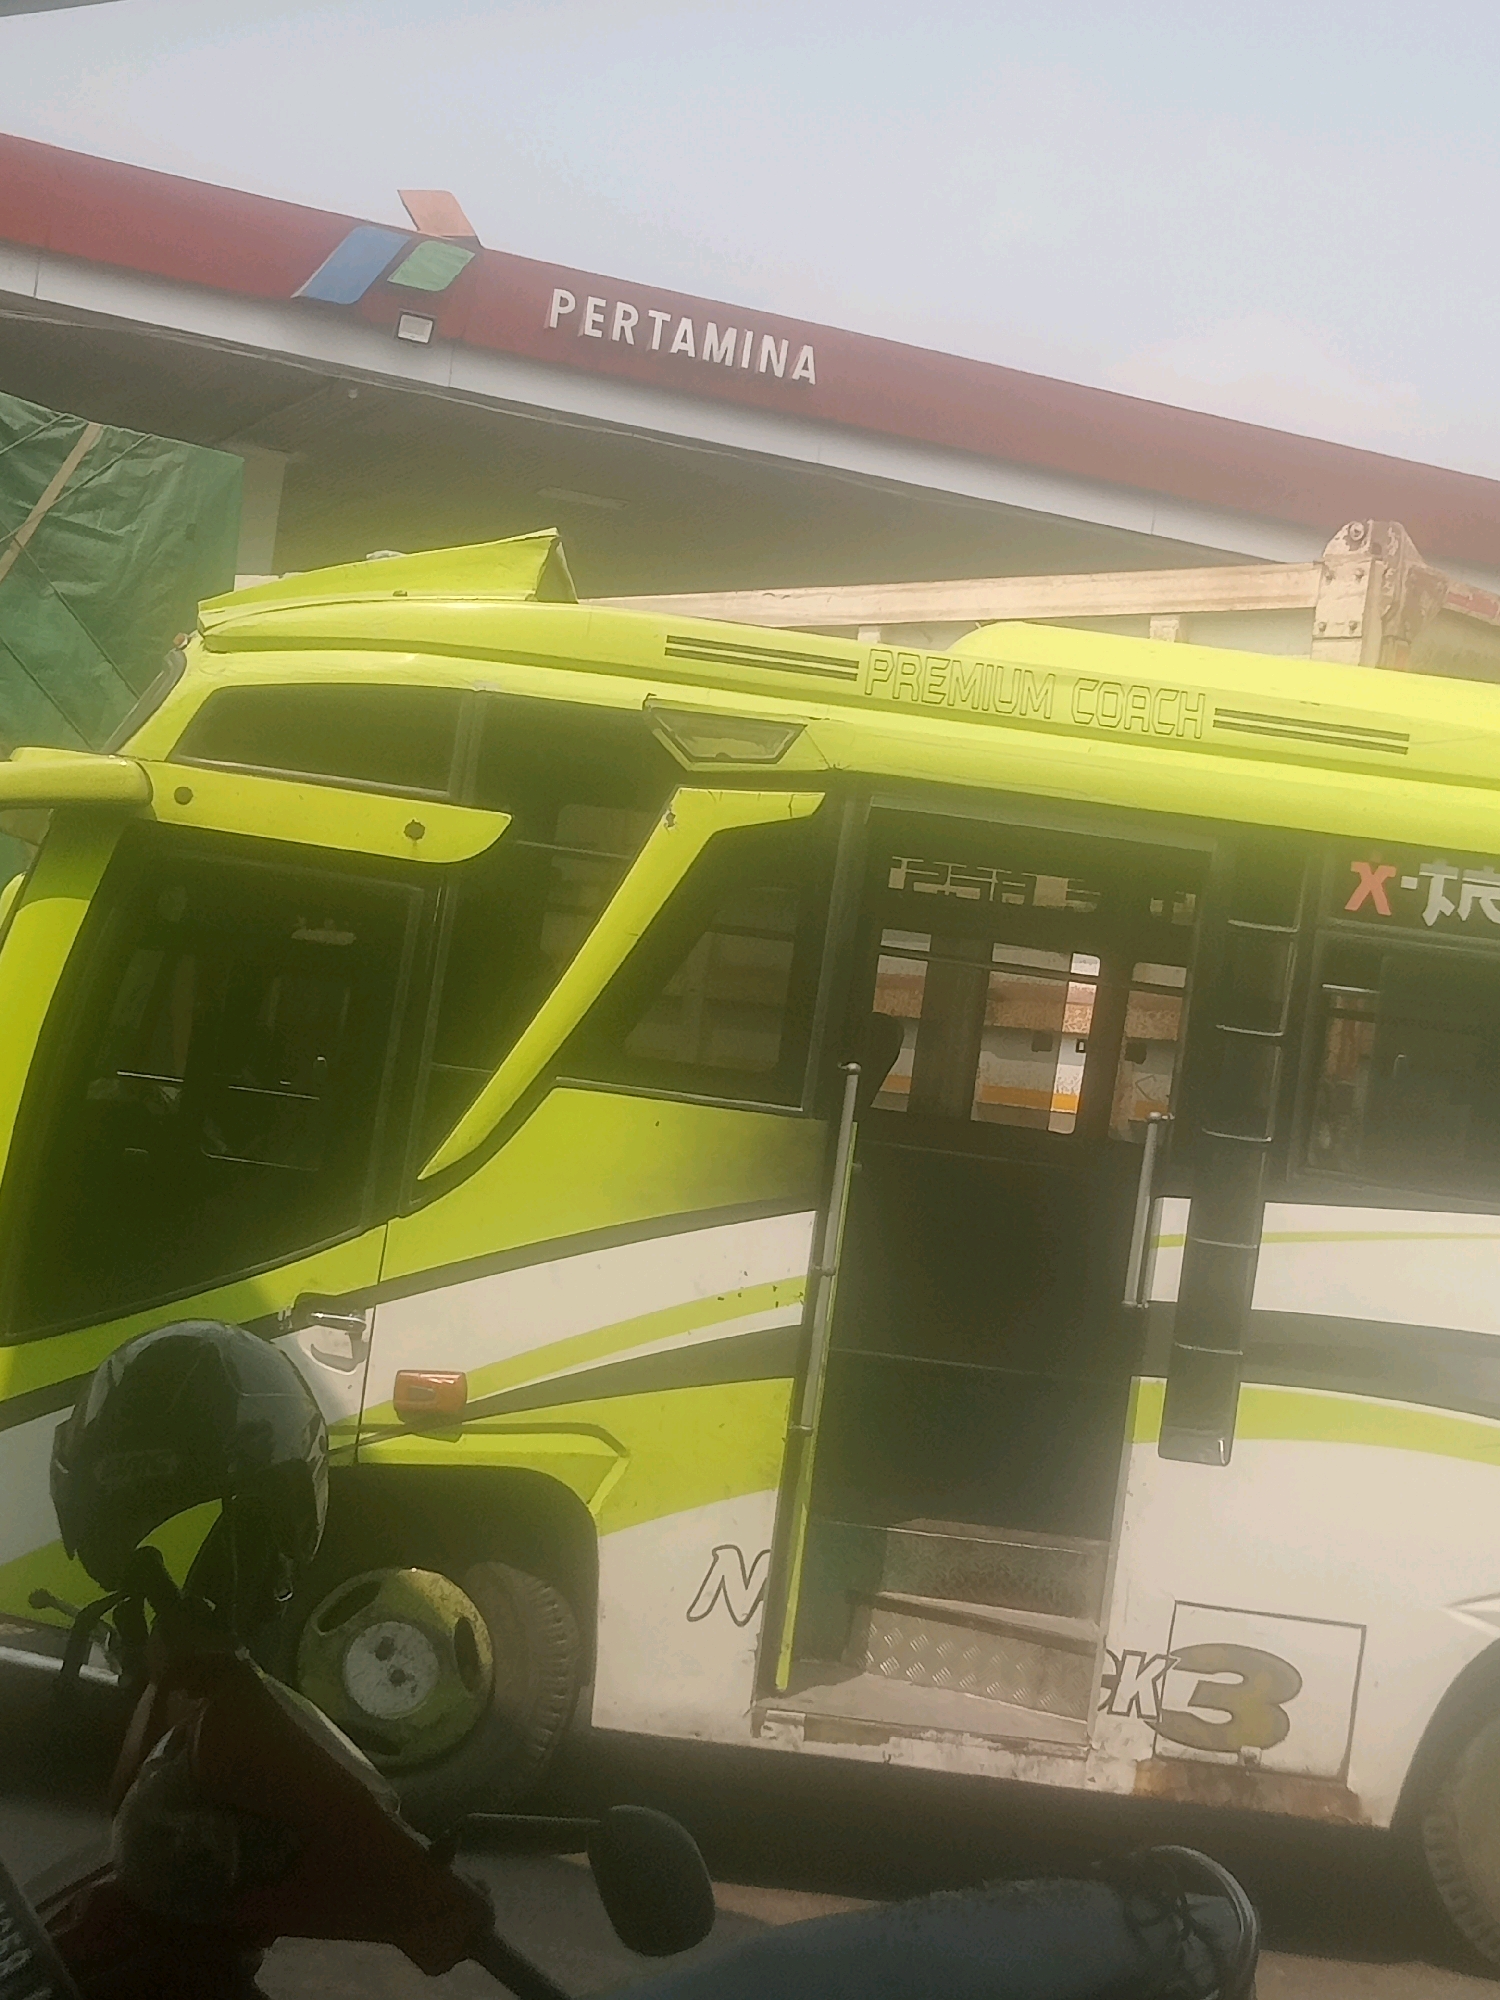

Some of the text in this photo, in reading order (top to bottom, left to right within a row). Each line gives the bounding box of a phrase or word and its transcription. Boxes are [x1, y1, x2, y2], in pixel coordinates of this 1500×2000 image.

[546, 287, 817, 386] PERTAMINA
[865, 648, 1205, 739] PREMIUM COACH
[1143, 1642, 1304, 1754] 3
